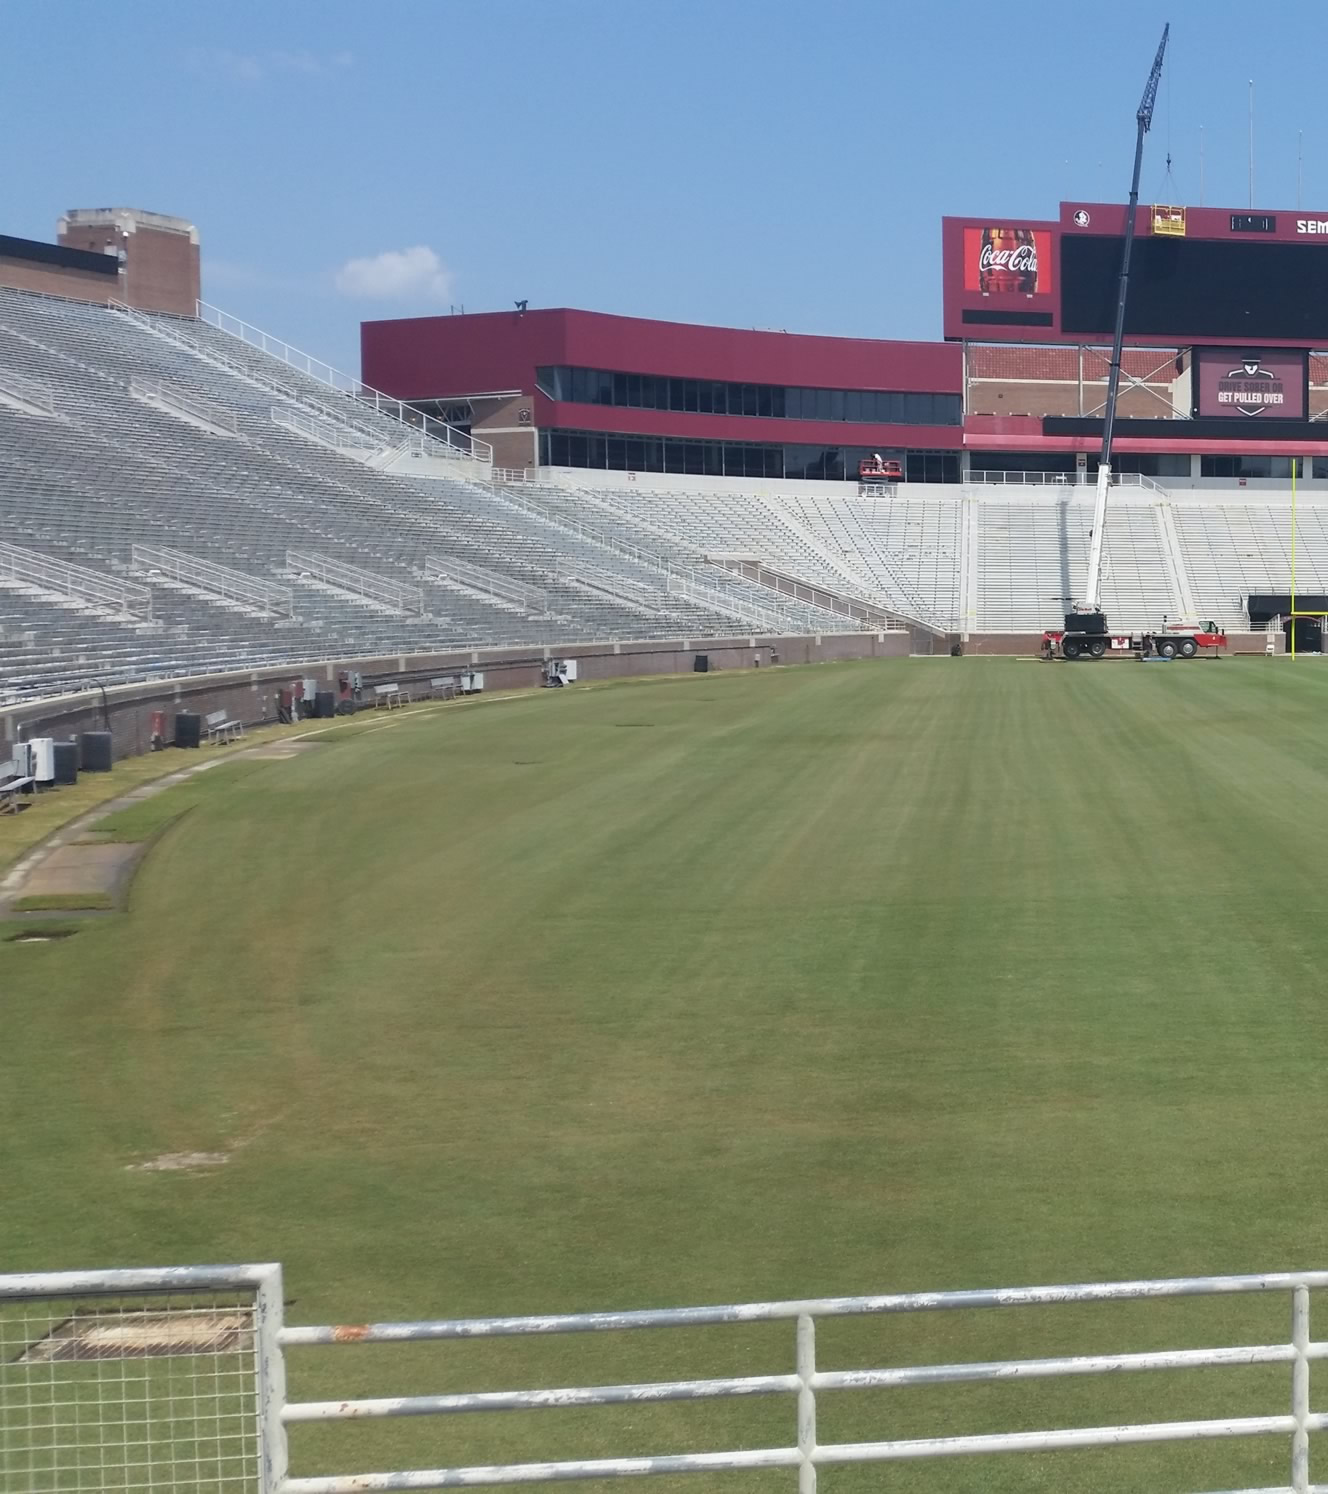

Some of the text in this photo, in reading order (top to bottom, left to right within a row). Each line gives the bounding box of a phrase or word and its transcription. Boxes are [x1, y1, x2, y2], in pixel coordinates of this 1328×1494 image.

[979, 244, 1038, 272] Coca-Cola
[1218, 381, 1283, 393] DRIVE SOBER OR
[1218, 392, 1284, 404] GET PULLED OVER
